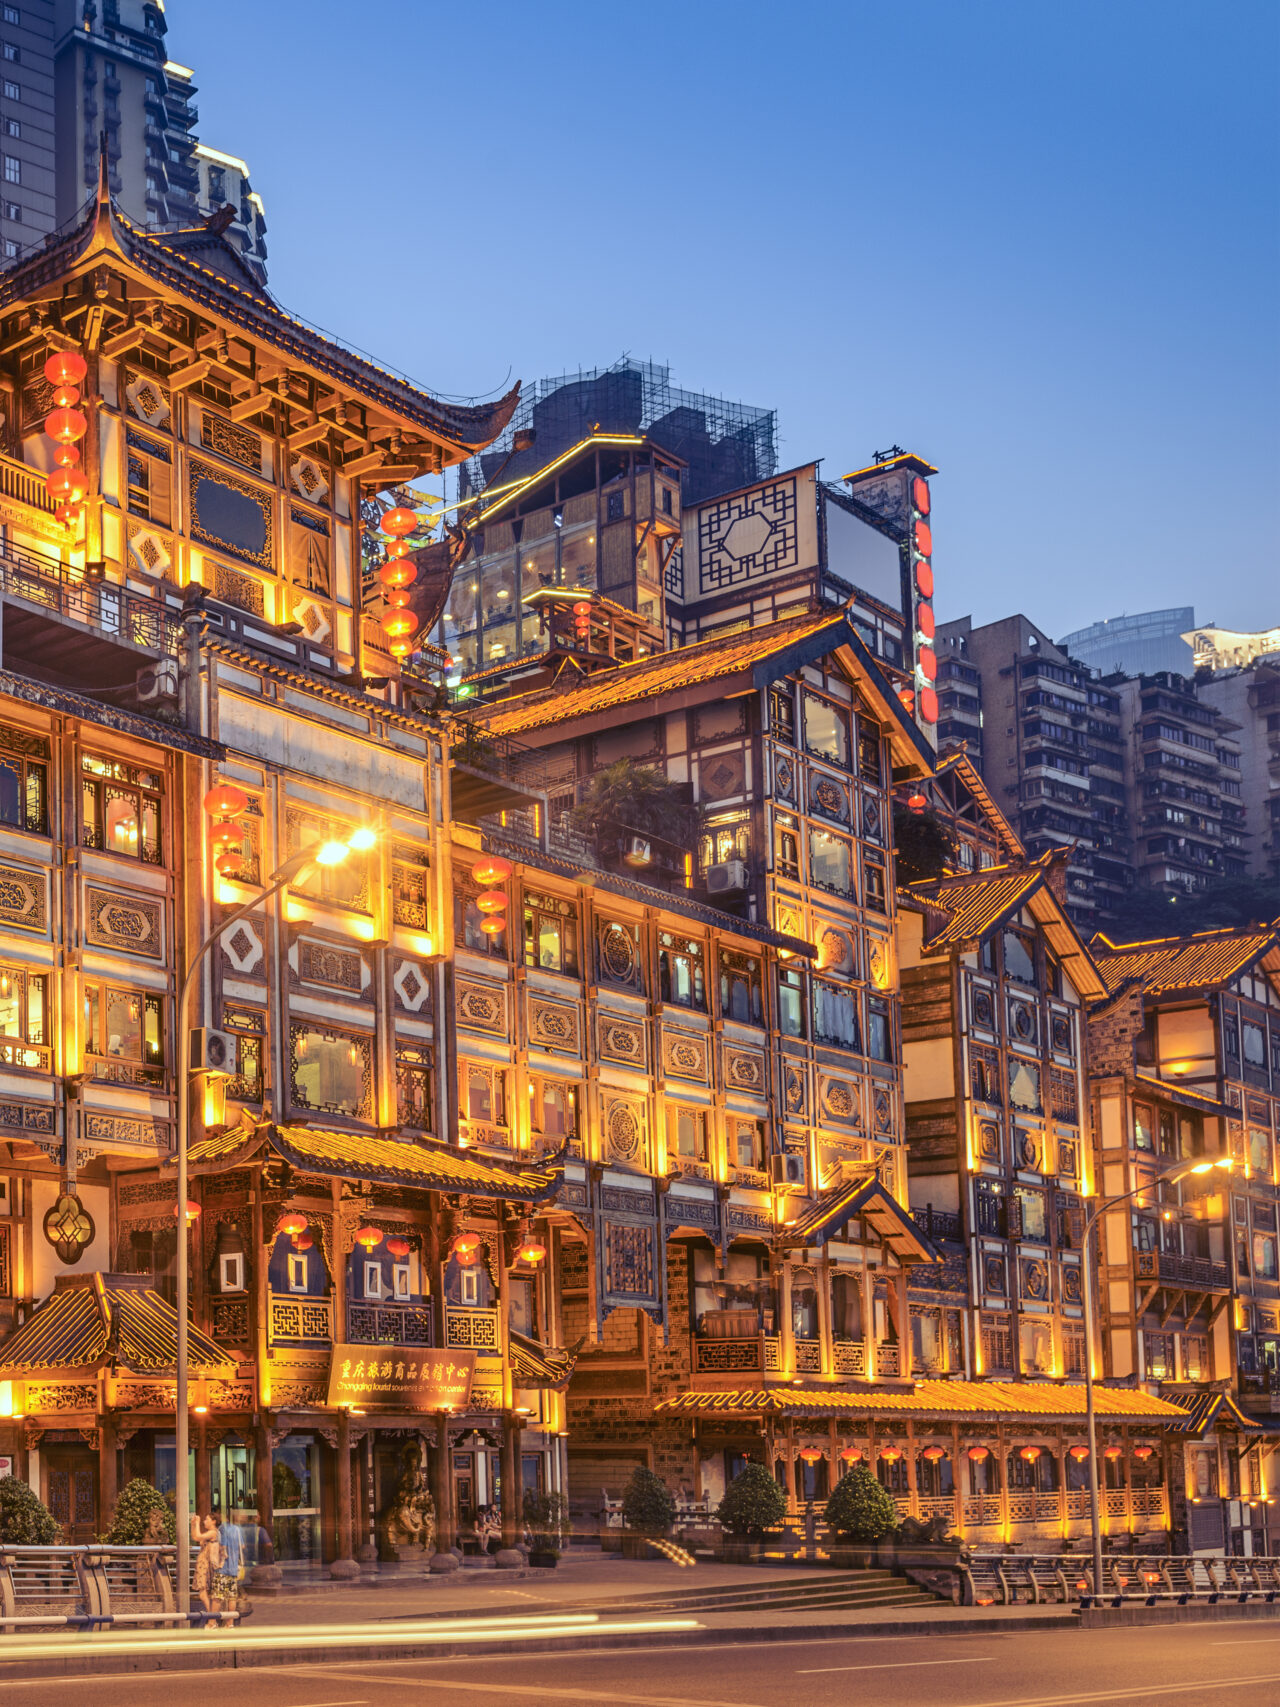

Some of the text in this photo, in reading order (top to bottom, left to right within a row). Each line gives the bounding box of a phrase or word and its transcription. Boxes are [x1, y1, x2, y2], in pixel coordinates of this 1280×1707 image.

[340, 1359, 470, 1382] 重庆旅游商品展销中心
[336, 1382, 372, 1393] Chongqing
